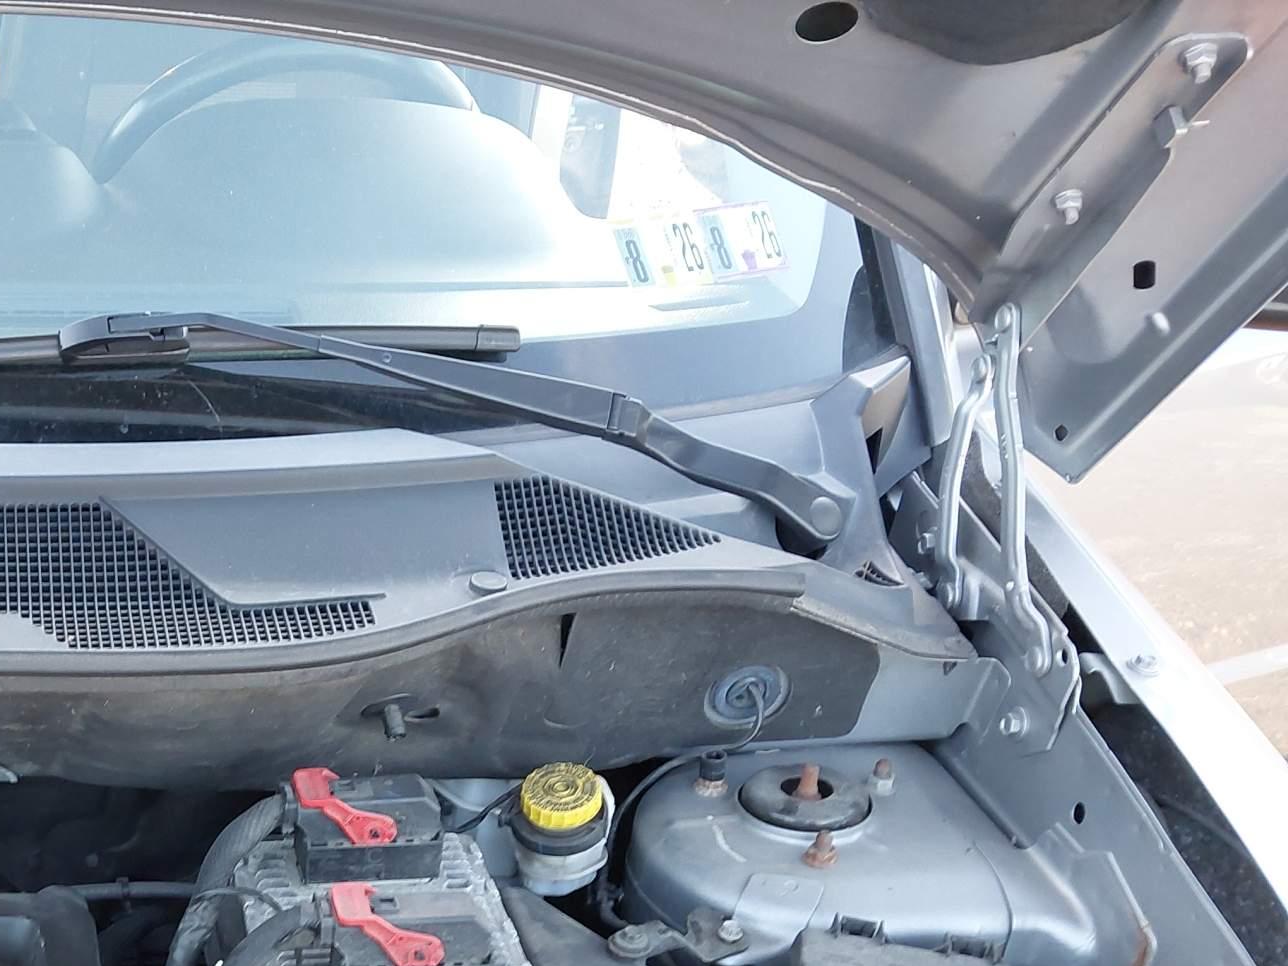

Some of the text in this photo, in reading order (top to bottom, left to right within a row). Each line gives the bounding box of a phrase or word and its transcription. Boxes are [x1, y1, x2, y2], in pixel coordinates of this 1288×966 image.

[672, 222, 705, 272] 26
[710, 226, 733, 270] 8
[751, 210, 782, 259] 26
